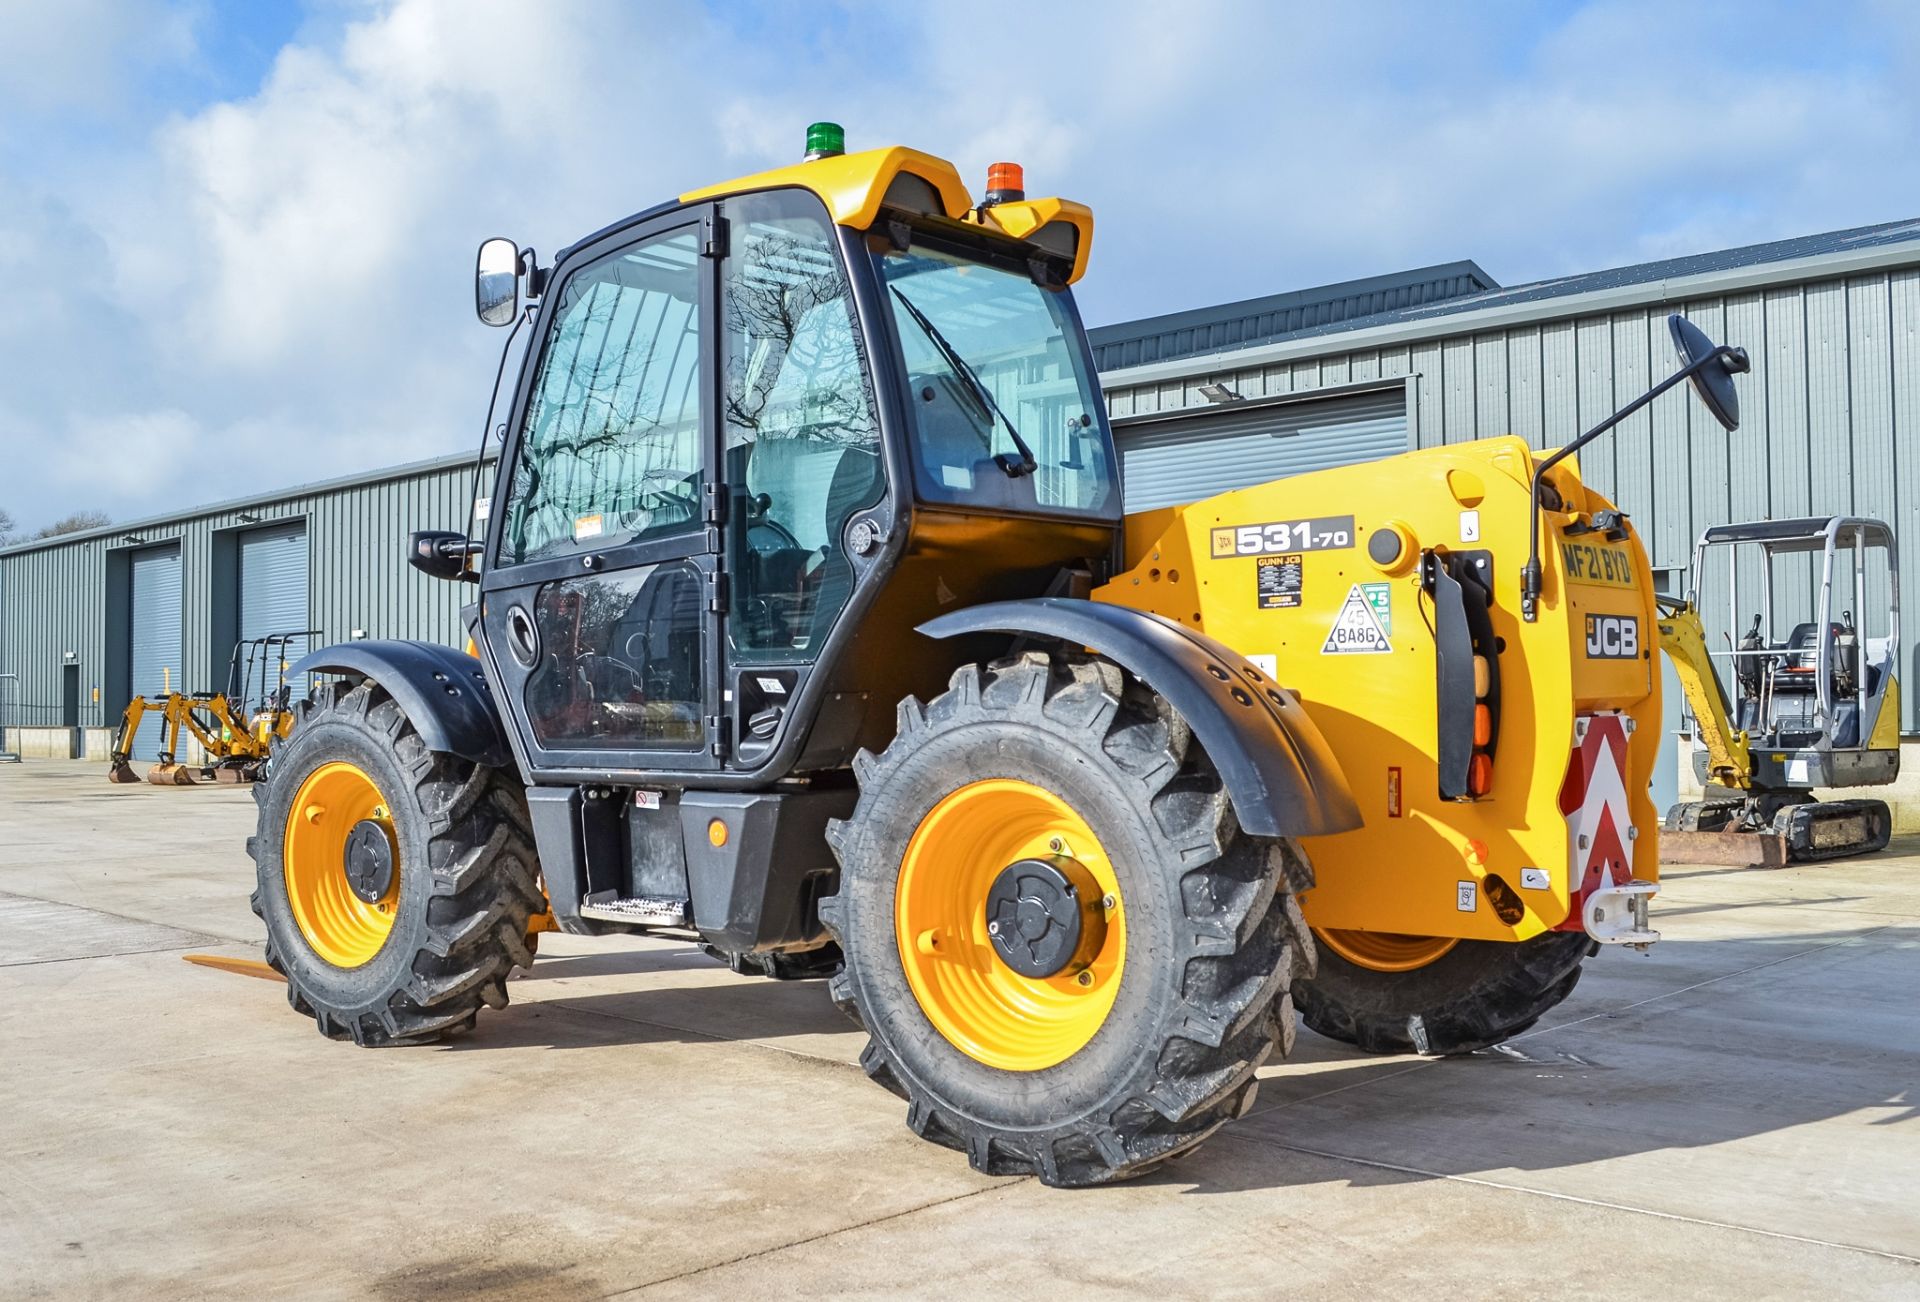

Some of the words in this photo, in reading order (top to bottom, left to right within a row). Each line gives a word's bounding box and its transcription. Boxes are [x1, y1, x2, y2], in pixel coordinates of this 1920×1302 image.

[1237, 521, 1349, 554] 531-70
[1258, 557, 1284, 567] GUNN
[1285, 555, 1301, 564] JCB
[1562, 543, 1602, 579] MF21
[1601, 548, 1631, 583] BYD
[1347, 609, 1365, 626] 45
[1337, 627, 1375, 643] BA8G
[1587, 617, 1638, 656] JCB
